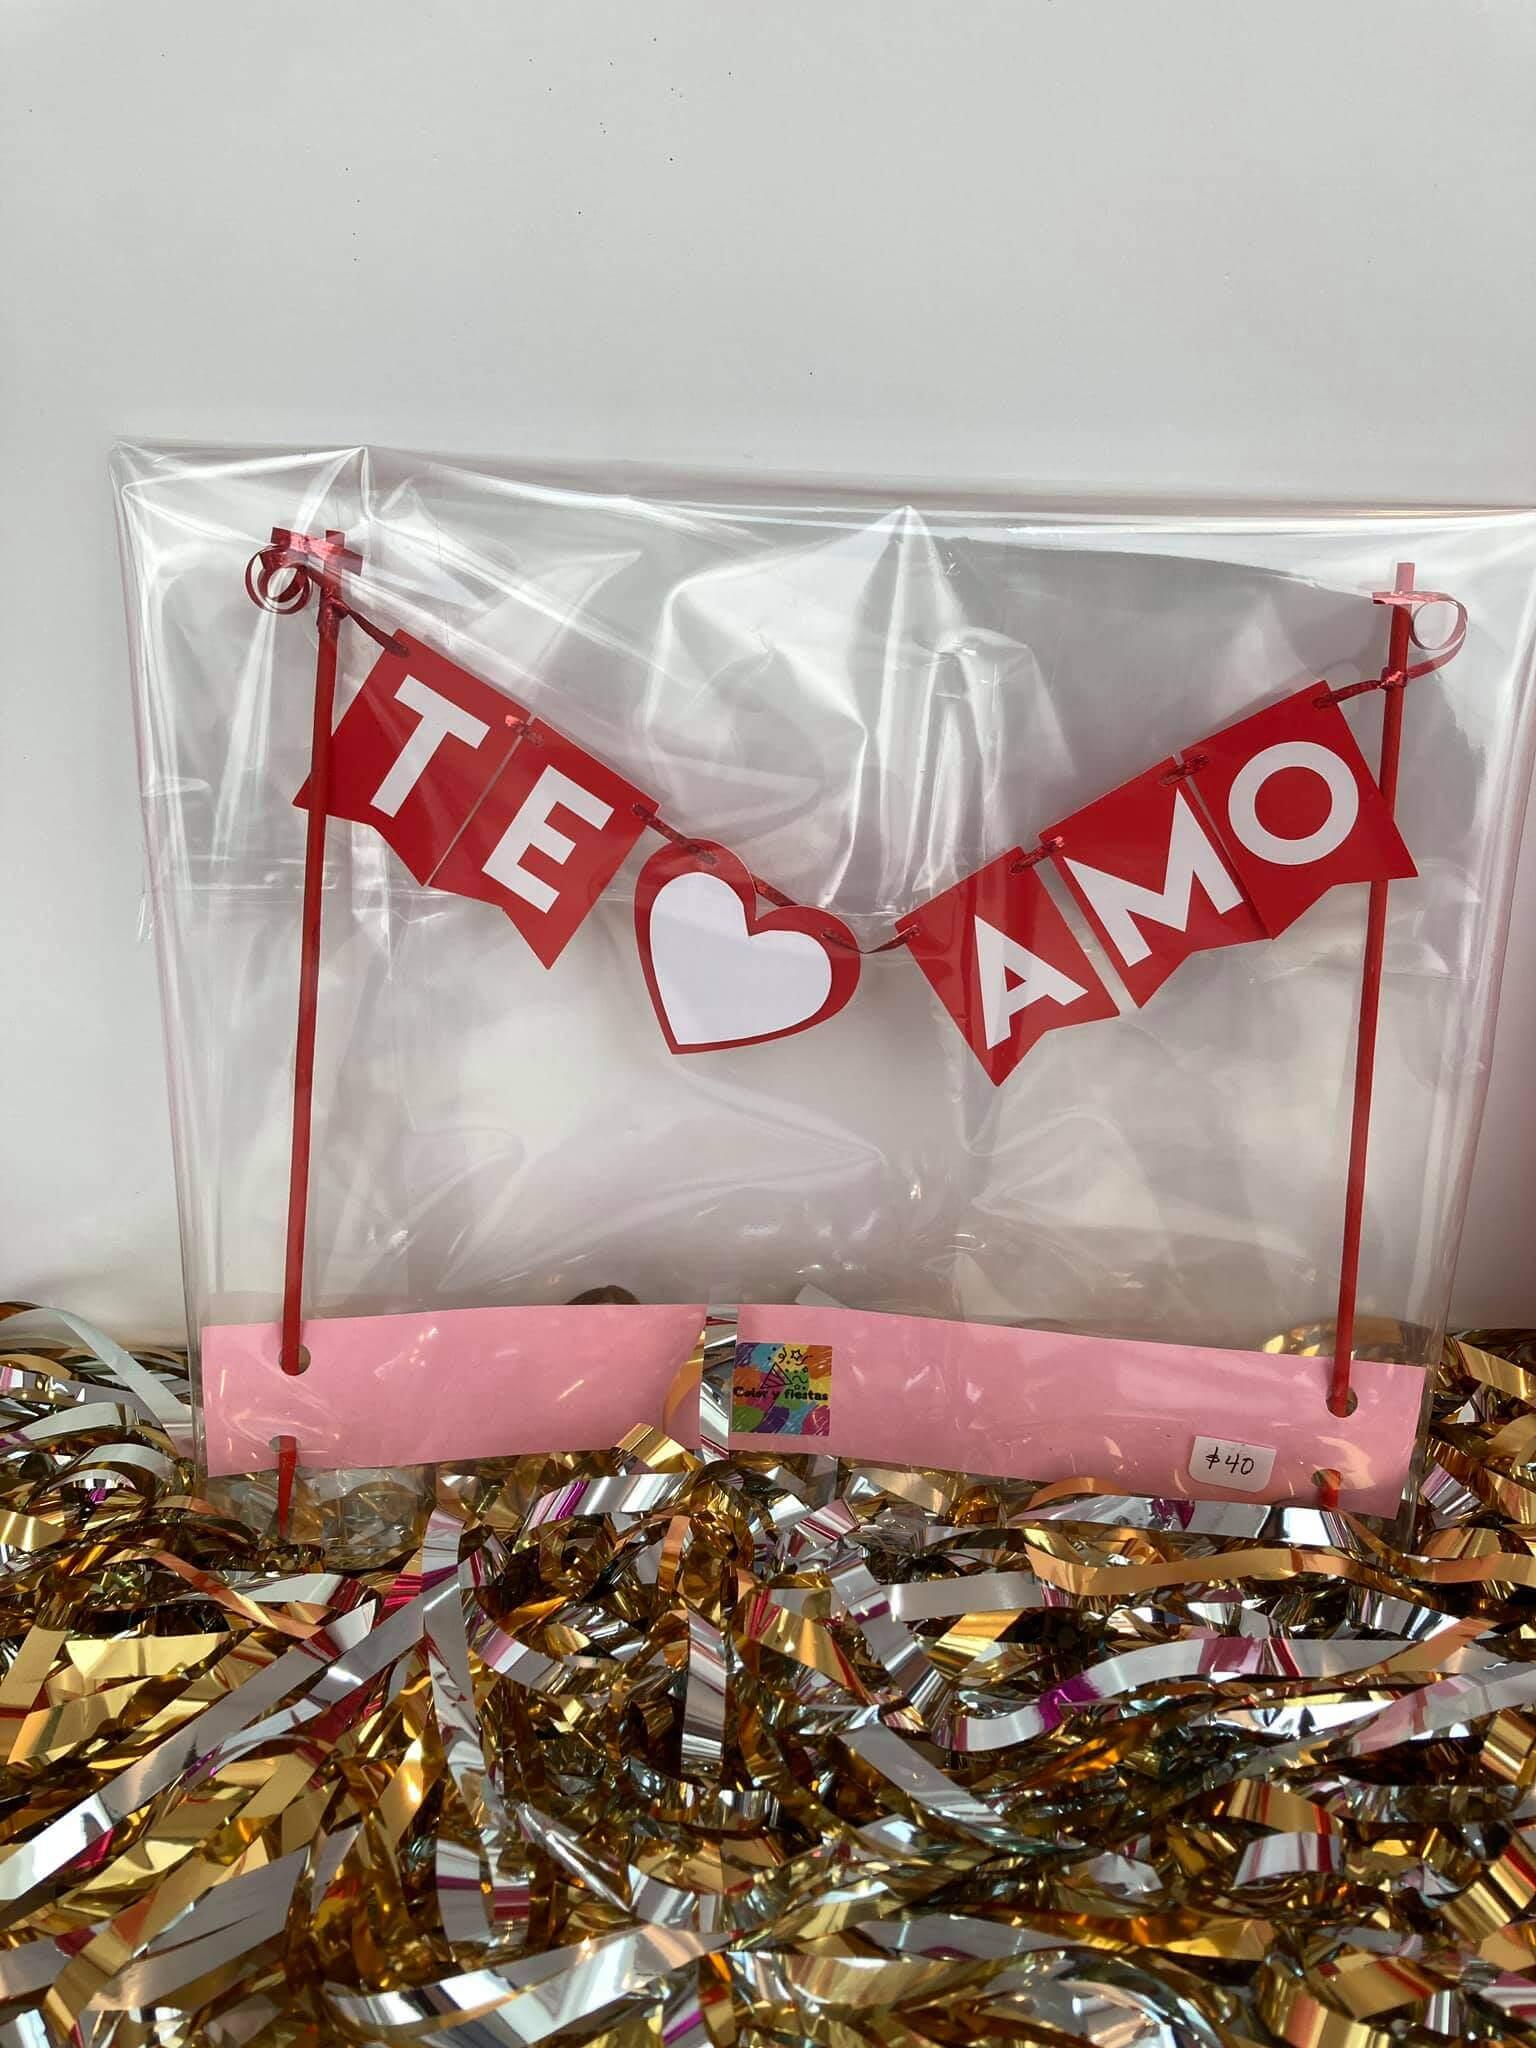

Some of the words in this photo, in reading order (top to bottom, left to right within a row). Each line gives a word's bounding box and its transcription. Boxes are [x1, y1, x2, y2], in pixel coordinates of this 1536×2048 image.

[370, 675, 614, 914] TE
[974, 741, 1359, 1049] AMO
[733, 1386, 768, 1398] Color
[784, 1389, 829, 1401] fiestas
[1205, 1446, 1255, 1475] $40
